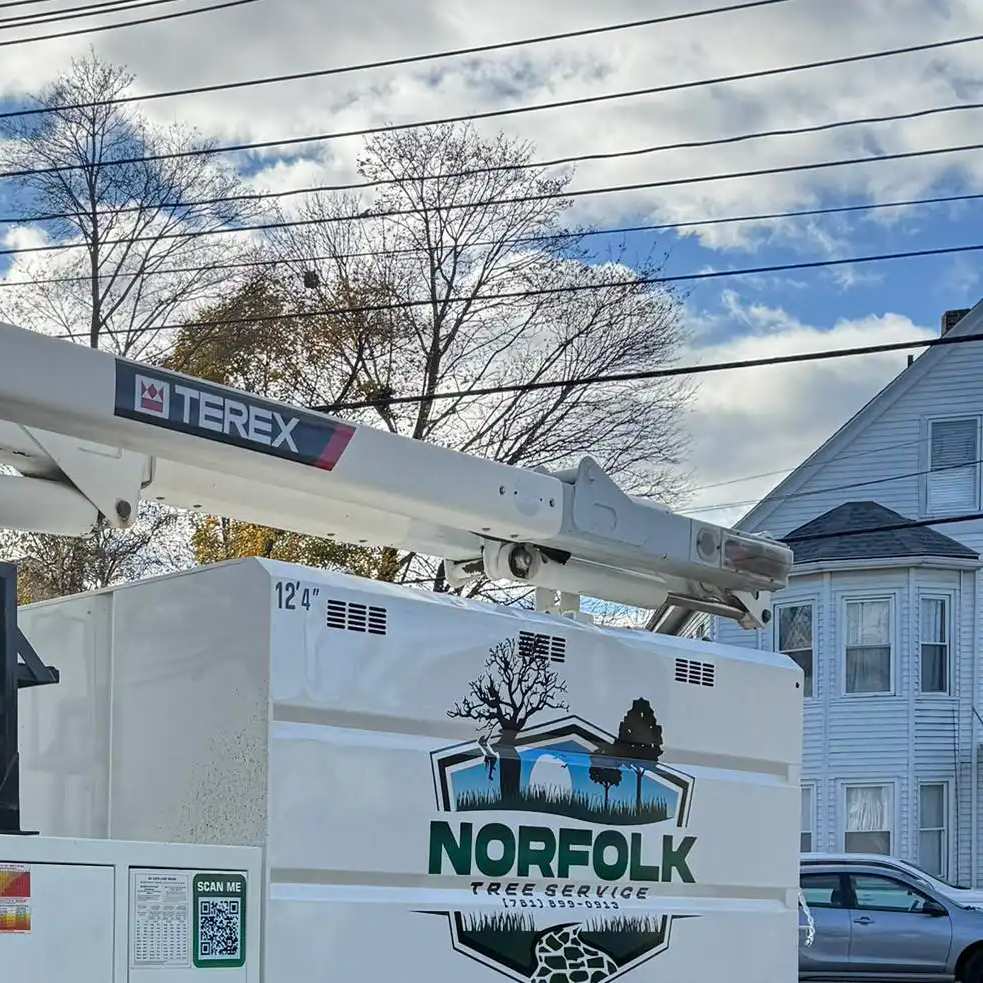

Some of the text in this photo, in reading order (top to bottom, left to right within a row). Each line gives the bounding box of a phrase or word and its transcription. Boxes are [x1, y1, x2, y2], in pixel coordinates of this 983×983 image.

[174, 384, 300, 453] TEREX
[428, 820, 698, 884] NORFOLK
[197, 881, 223, 892] SCAN
[226, 882, 242, 892] ME
[470, 882, 649, 900] TREE SERVICE
